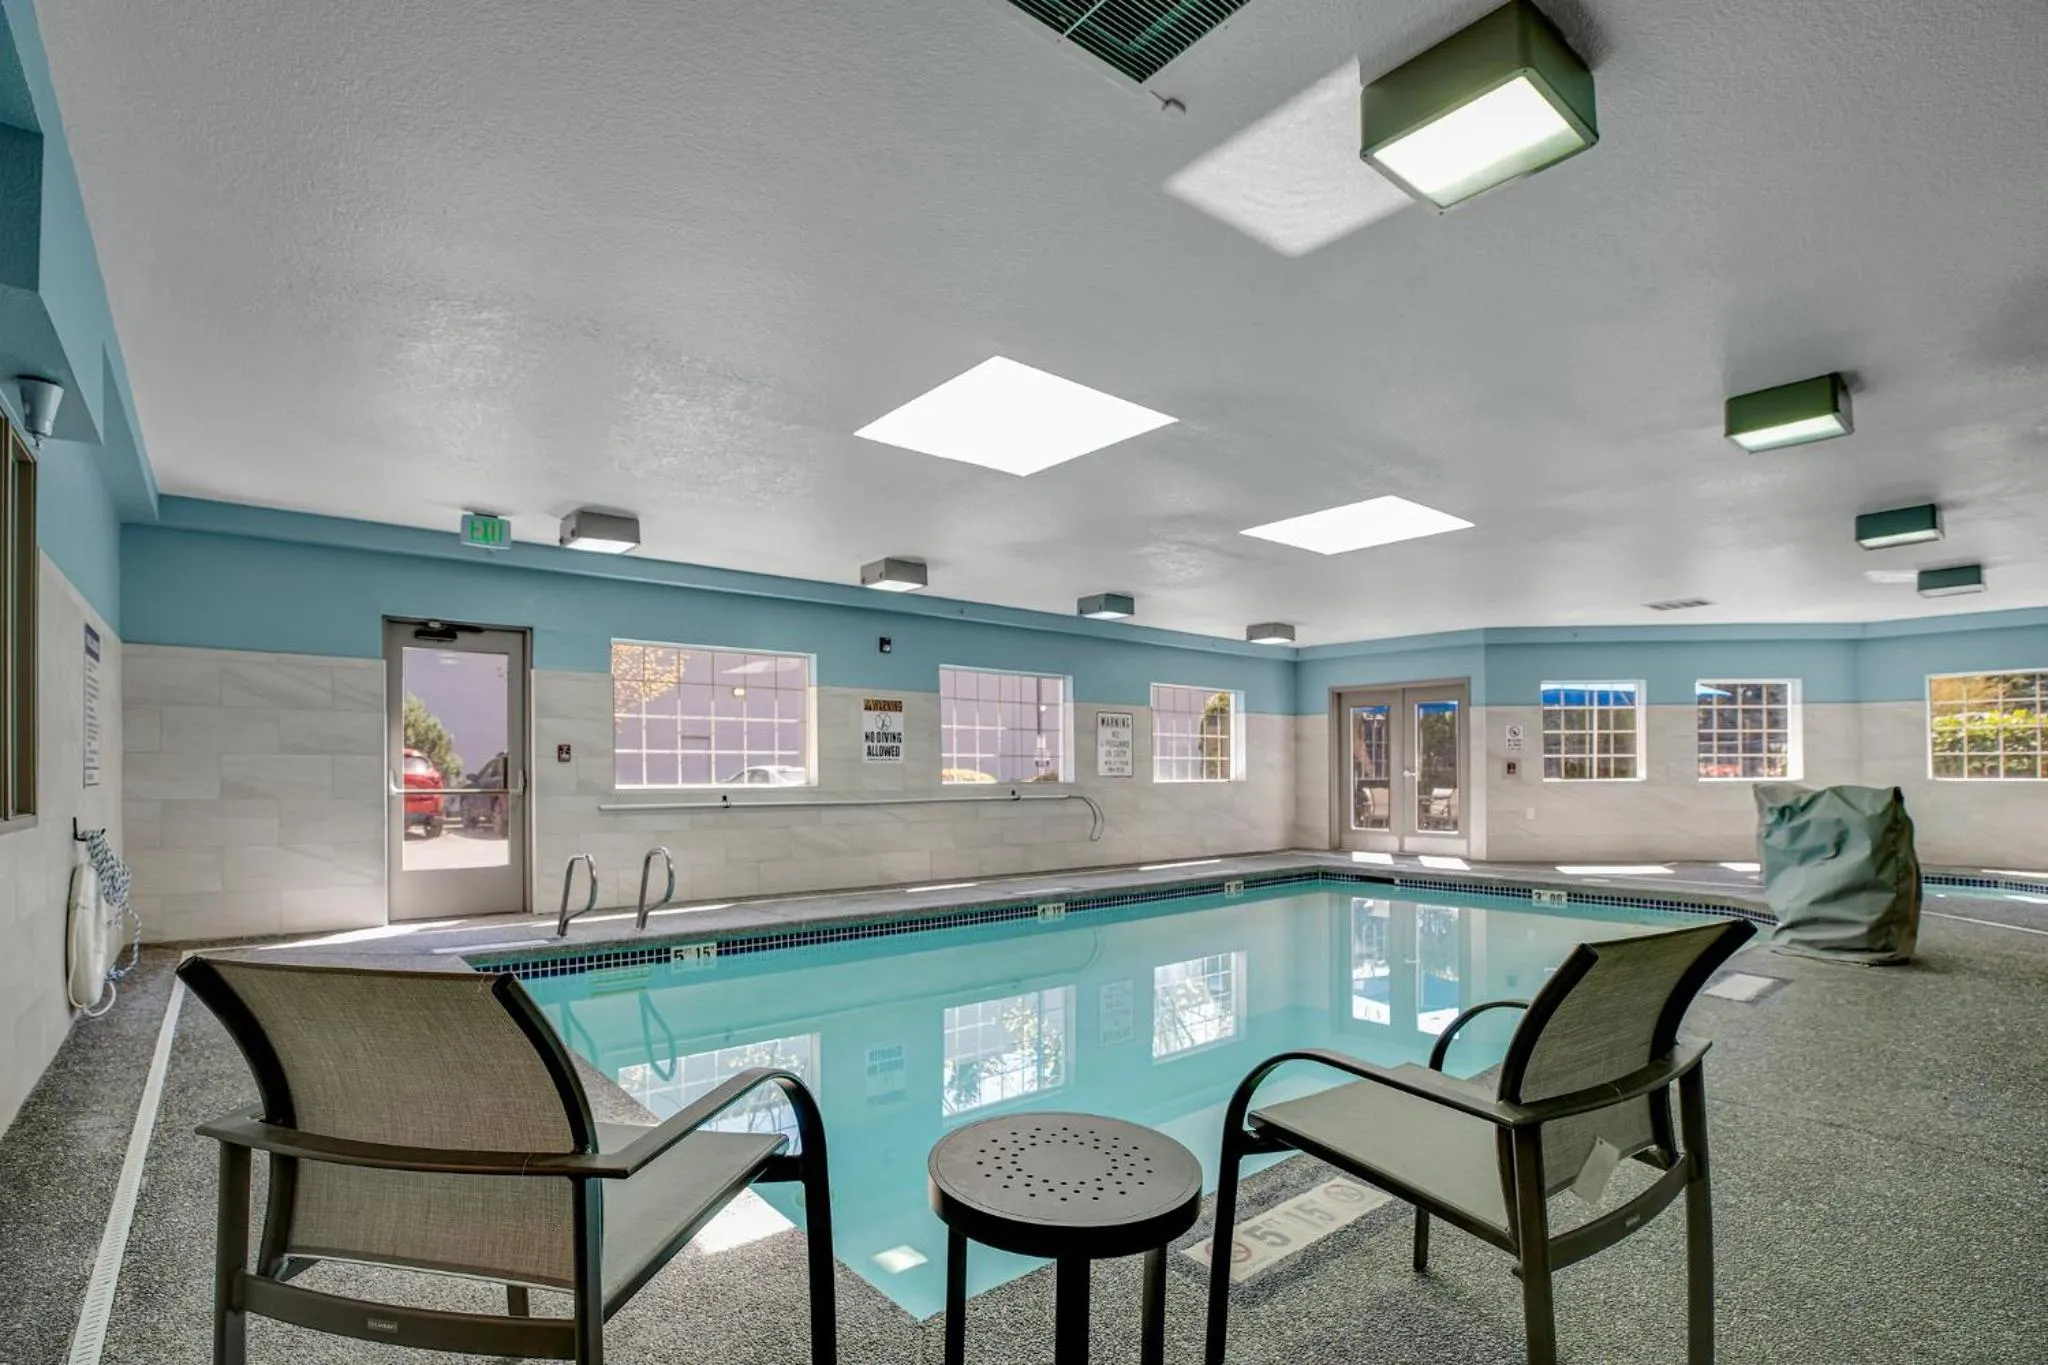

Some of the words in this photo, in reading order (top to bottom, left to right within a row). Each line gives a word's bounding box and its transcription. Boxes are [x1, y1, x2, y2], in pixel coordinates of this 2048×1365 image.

[469, 519, 503, 545] EXIT
[1101, 716, 1130, 728] WARNING
[865, 731, 875, 743] NO
[877, 731, 902, 743] DIVING
[867, 745, 900, 757] ALLOWED
